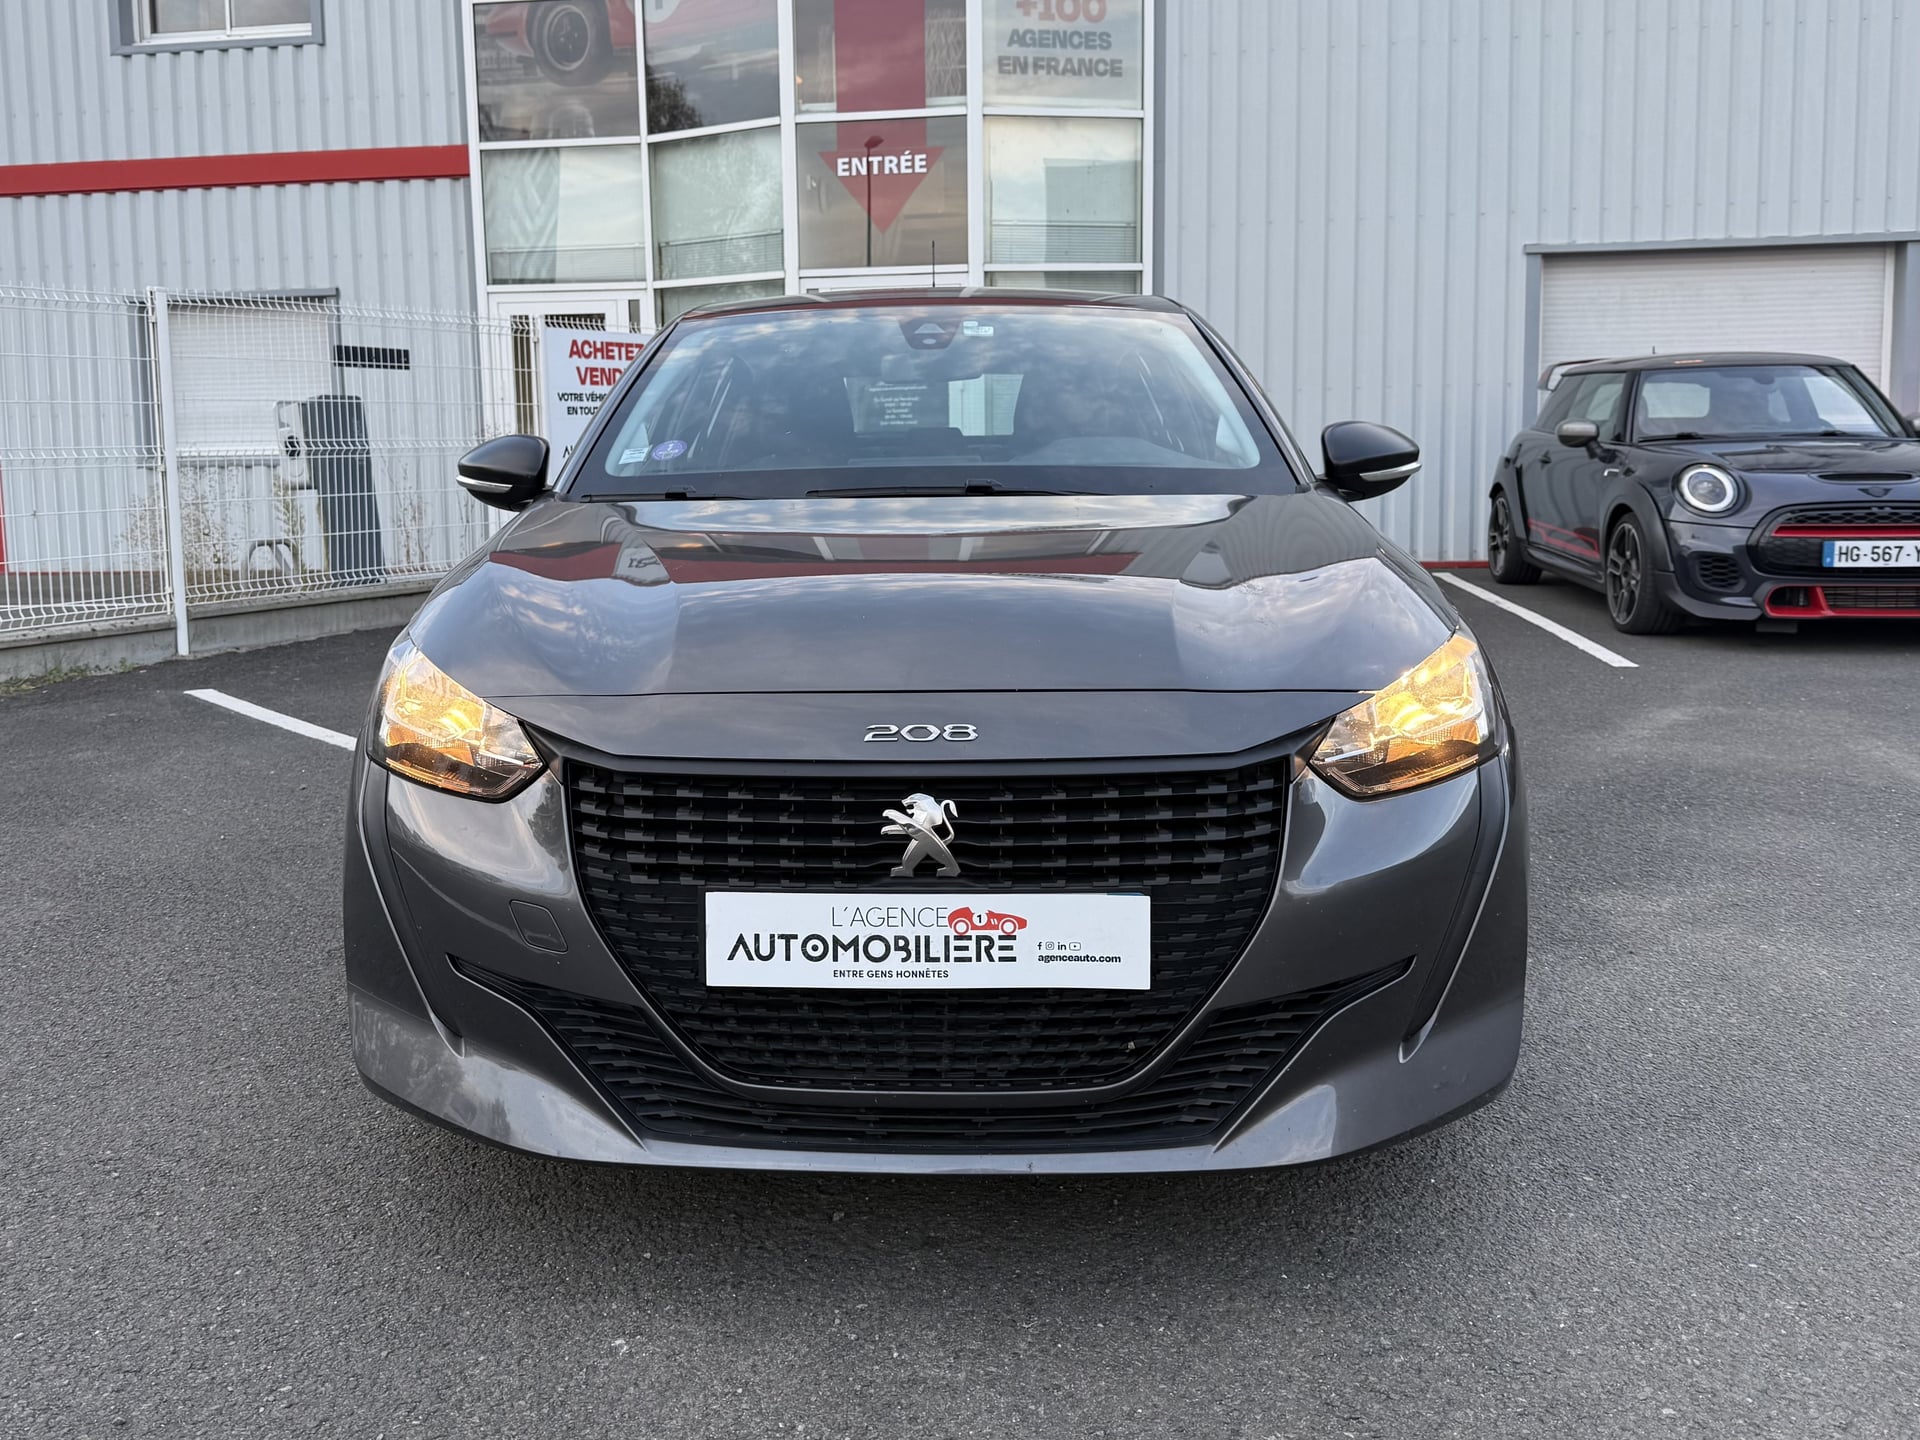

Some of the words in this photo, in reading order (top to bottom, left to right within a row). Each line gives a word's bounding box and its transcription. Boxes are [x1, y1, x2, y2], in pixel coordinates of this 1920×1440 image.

[1007, 29, 1112, 50] AGENCES
[998, 56, 1028, 75] EN
[1032, 56, 1123, 77] FRANCE
[837, 150, 927, 176] ENTRÉE
[576, 366, 625, 386] VEND
[557, 392, 584, 402] VOTRE
[567, 406, 578, 415] EN
[863, 723, 979, 741] 208
[832, 906, 948, 928] L'AGENCE
[1038, 954, 1121, 963] agenceauto.com
[833, 969, 864, 978] ENTRE
[866, 969, 893, 978] GENS
[896, 967, 949, 978] HONNÊTES
